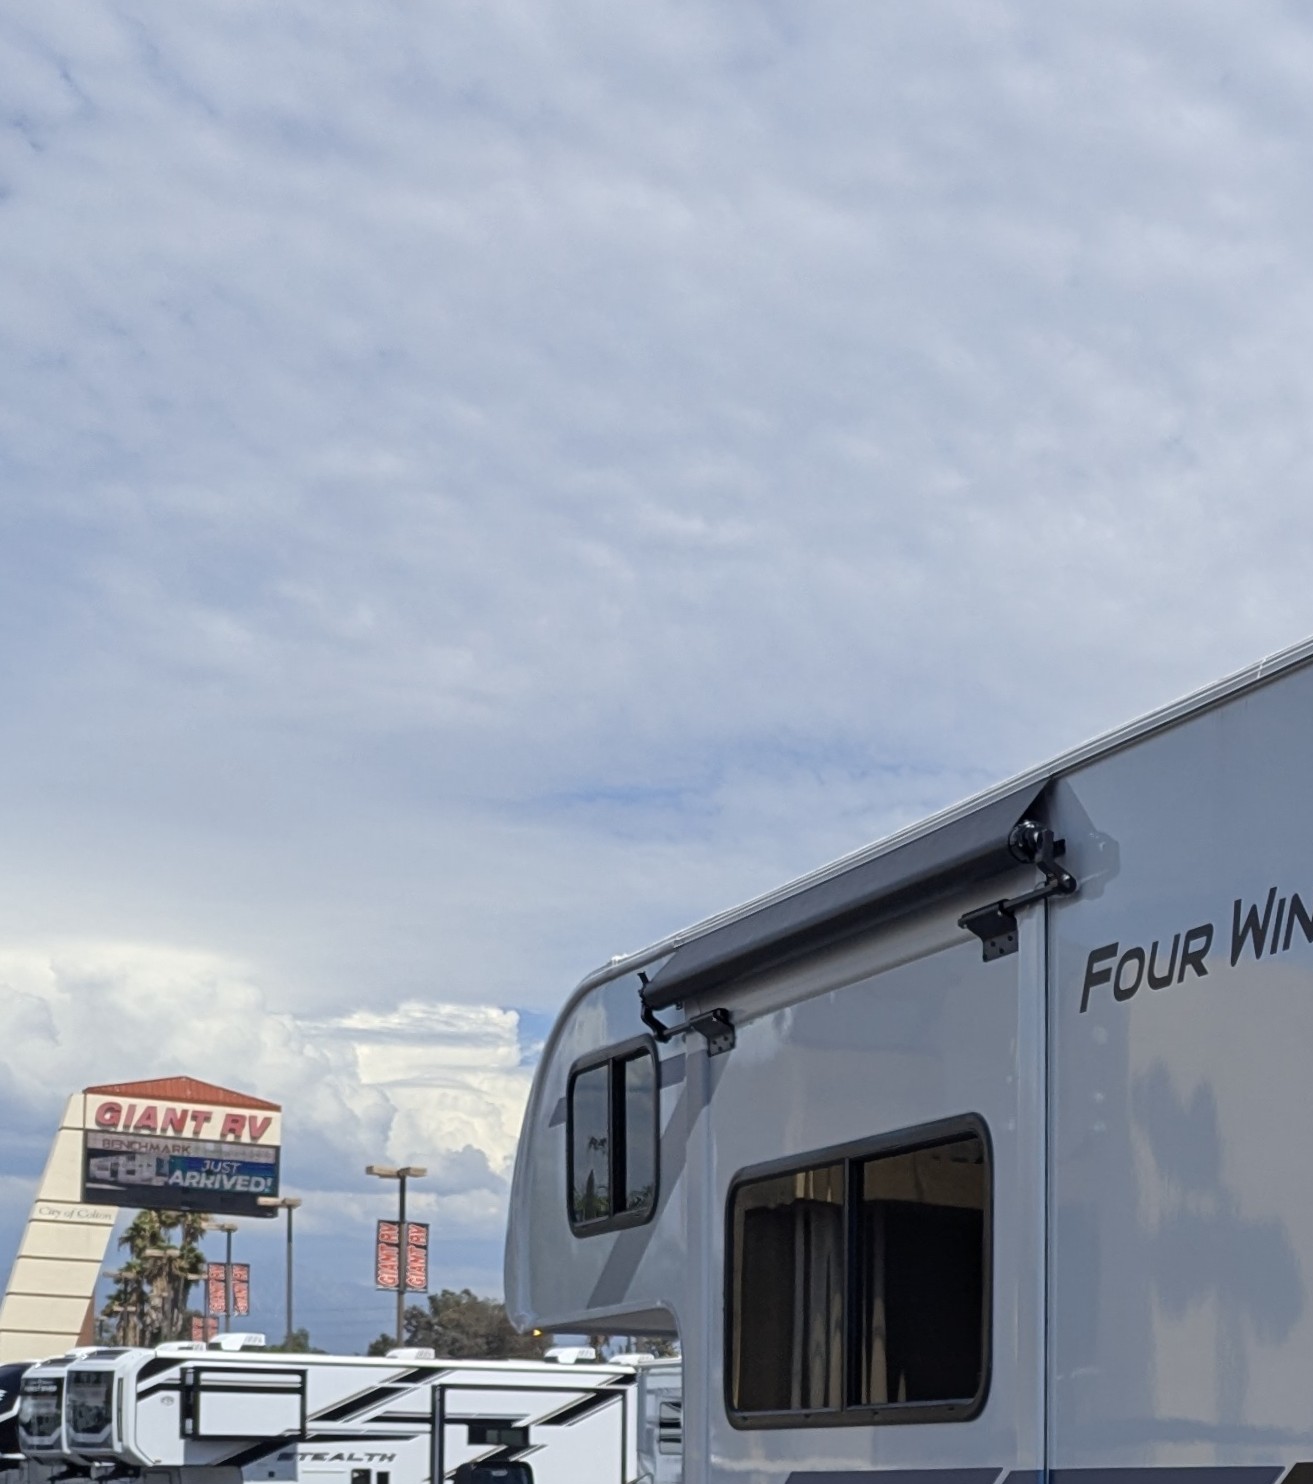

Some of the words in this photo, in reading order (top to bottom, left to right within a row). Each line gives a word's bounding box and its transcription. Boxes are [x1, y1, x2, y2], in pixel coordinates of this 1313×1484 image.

[1079, 923, 1214, 1014] FOUR
[95, 1102, 213, 1138] GIANT
[220, 1113, 273, 1143] RV
[102, 1138, 191, 1155] BENCHMARK
[201, 1160, 242, 1174] JUST
[168, 1170, 273, 1193] ARRIVED!
[39, 1206, 60, 1218] City
[64, 1208, 74, 1219] of
[77, 1208, 112, 1220] Colton
[379, 1223, 399, 1244] RV
[408, 1224, 427, 1246] RV
[378, 1243, 399, 1287] GIANT
[406, 1246, 427, 1289] GIANT
[277, 1452, 397, 1462] STEALTH
